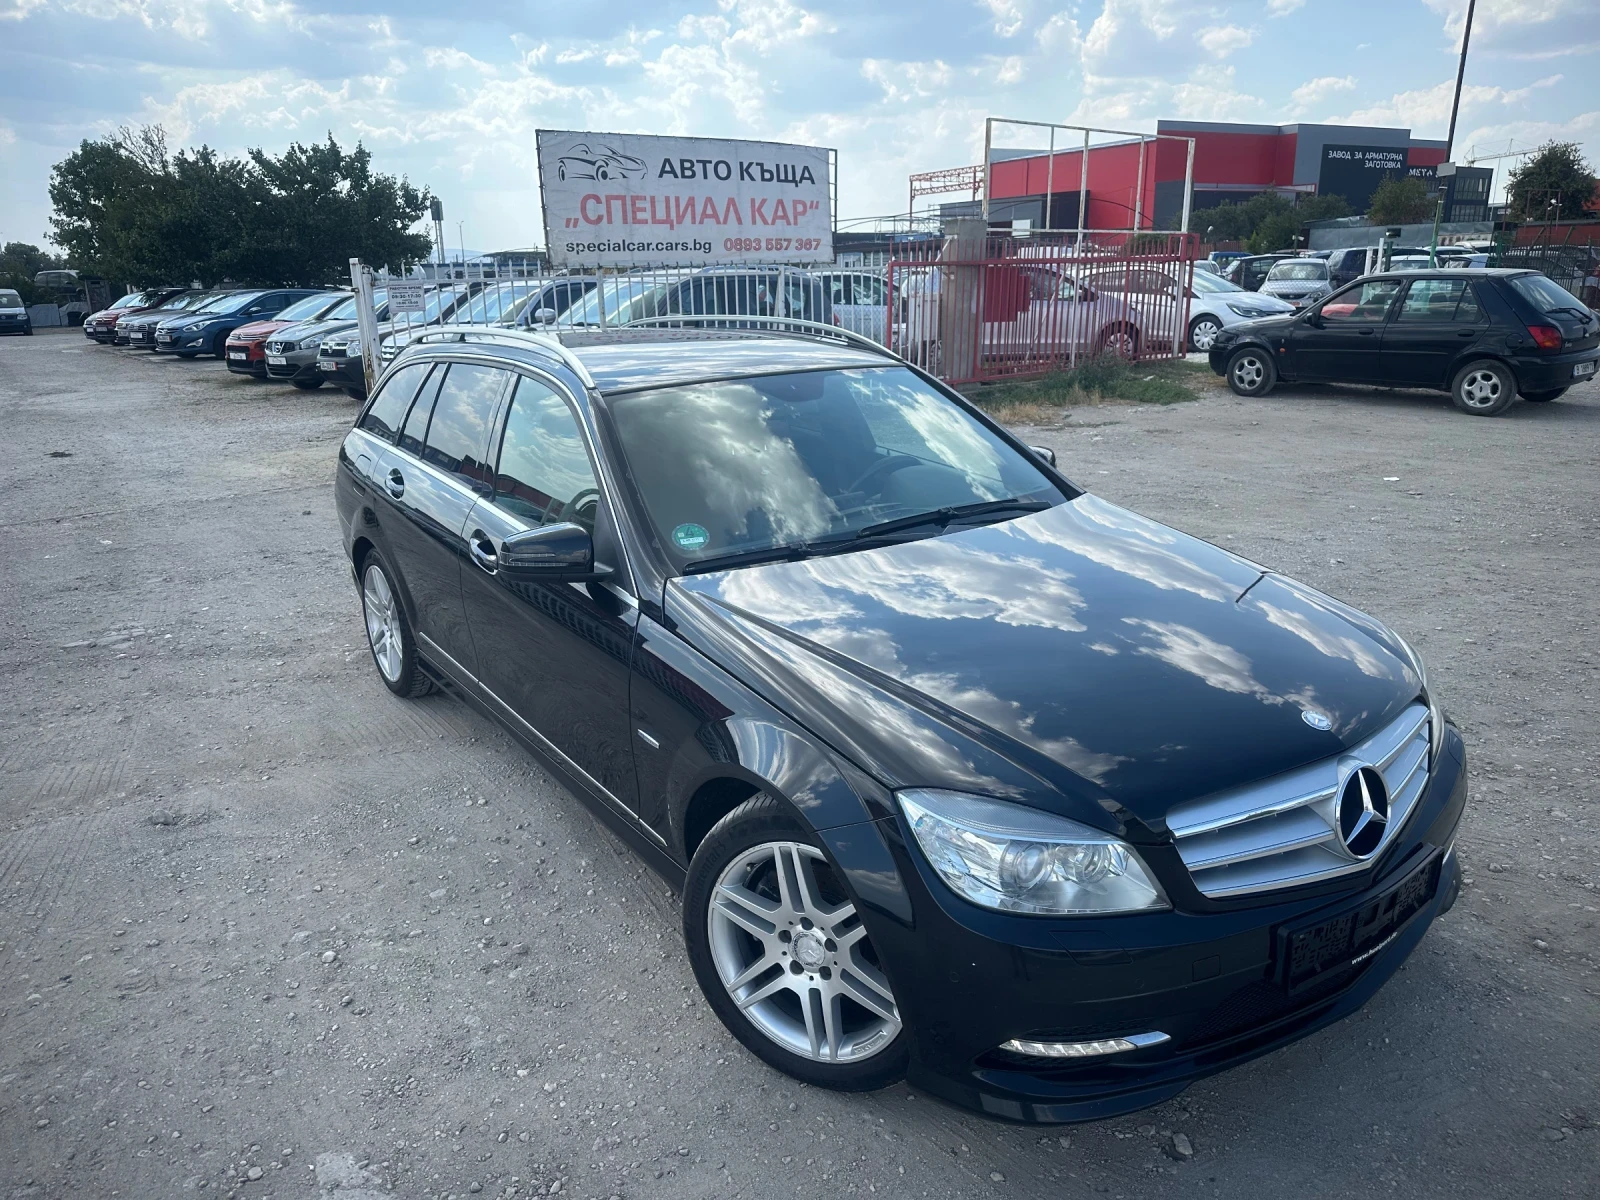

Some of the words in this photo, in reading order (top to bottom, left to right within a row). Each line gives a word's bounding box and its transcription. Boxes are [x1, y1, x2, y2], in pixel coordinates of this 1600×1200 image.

[1328, 150, 1351, 160] ЗАВОД
[1354, 151, 1363, 160] ЗА
[1365, 151, 1403, 161] АРМАТУРНА
[658, 157, 732, 181] АВТО
[739, 161, 815, 187] КЪЩА
[1364, 160, 1401, 169] ЗАГОТОВКА
[564, 193, 743, 231] „СПЕЦИАЛ
[565, 238, 712, 255] specialcar.cars.bg
[723, 237, 762, 251] 0893
[765, 238, 792, 251] 557
[794, 238, 821, 251] 367
